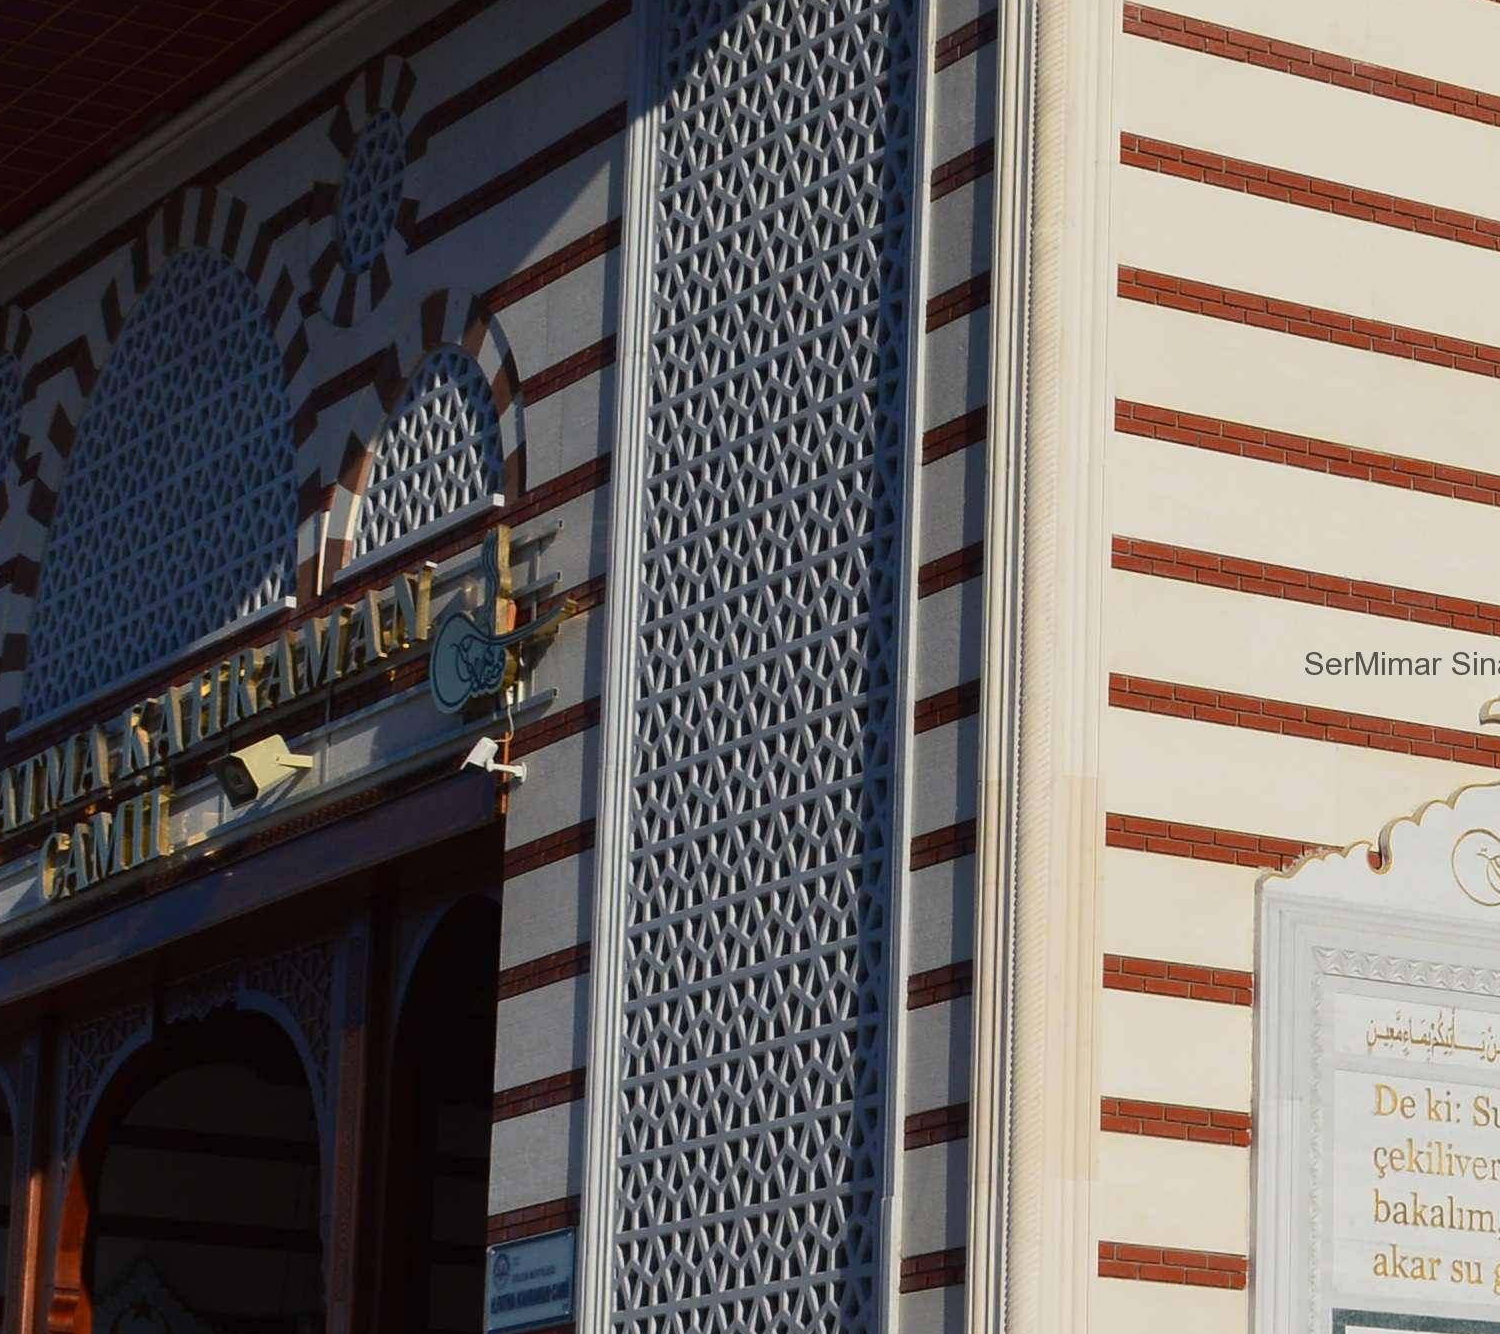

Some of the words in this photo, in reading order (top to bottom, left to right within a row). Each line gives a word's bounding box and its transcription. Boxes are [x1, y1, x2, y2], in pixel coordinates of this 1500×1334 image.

[121, 561, 438, 779] KAHRAMAN
[1373, 1083, 1416, 1118] De
[1426, 1088, 1461, 1123] ki:
[1372, 1244, 1441, 1281] akar
[1451, 1259, 1483, 1285] su
